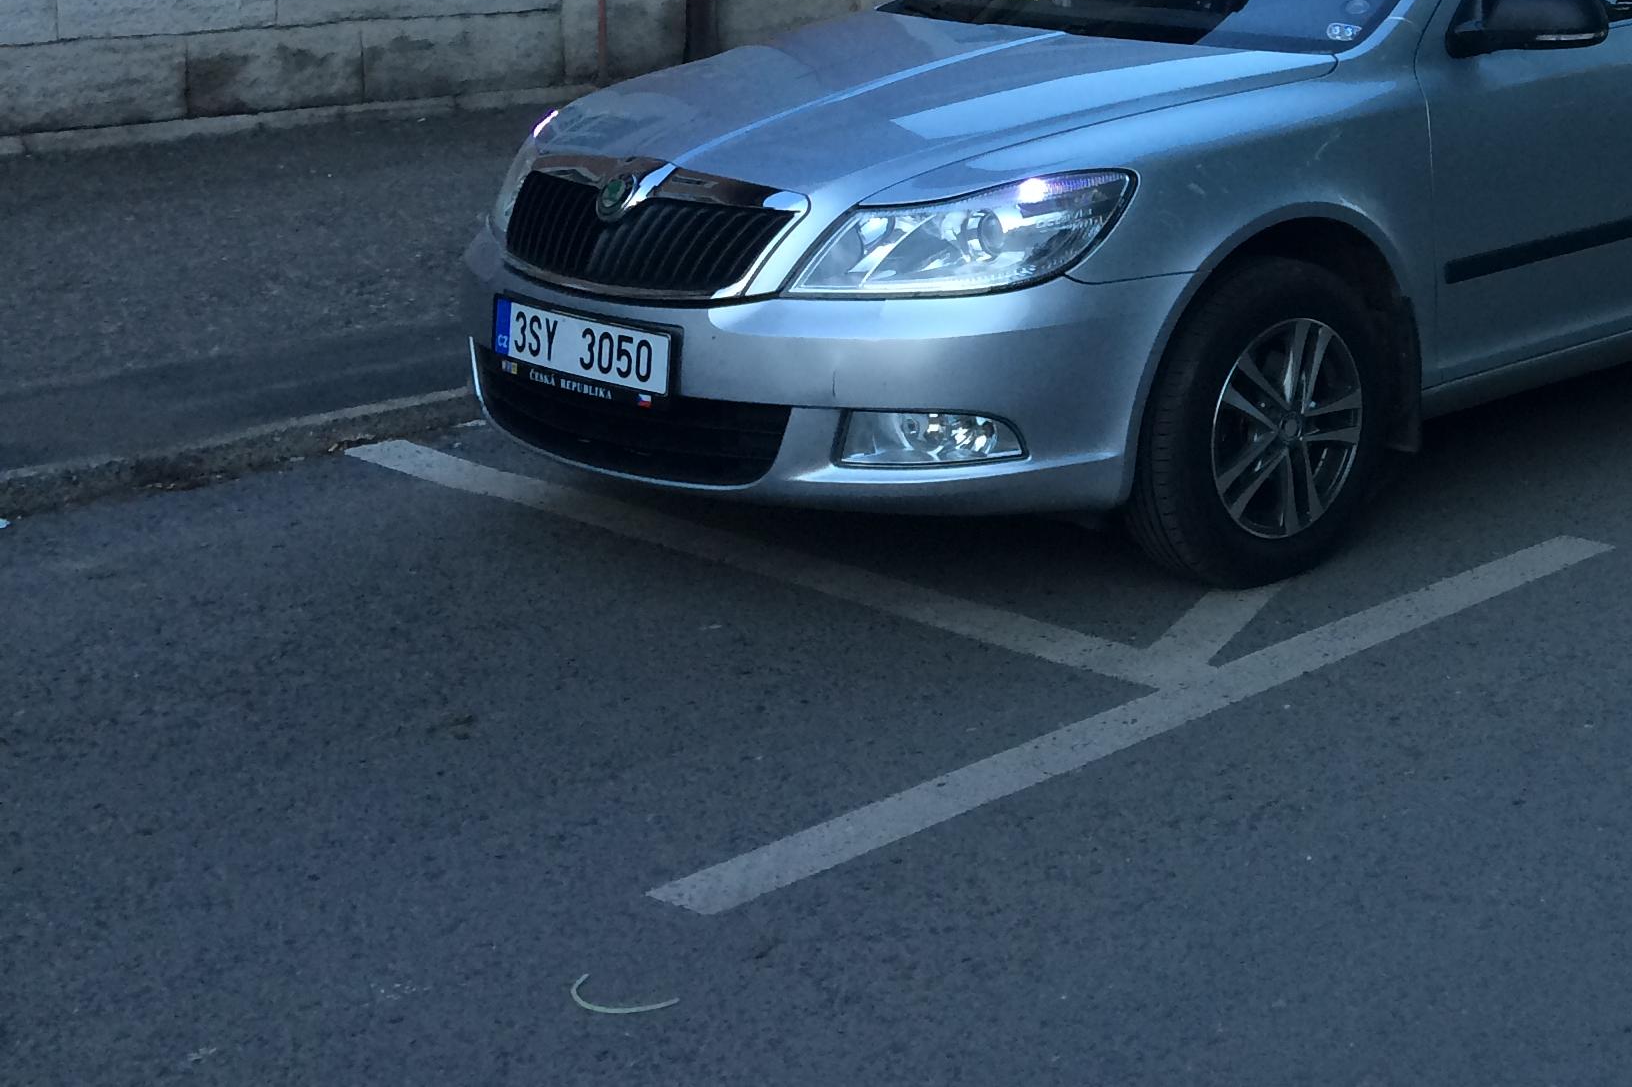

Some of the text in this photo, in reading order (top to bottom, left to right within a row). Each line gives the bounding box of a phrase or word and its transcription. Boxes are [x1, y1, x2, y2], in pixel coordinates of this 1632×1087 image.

[497, 333, 509, 349] CZ
[514, 311, 653, 383] 3SY 3050
[529, 369, 613, 400] ČESKÁ REPUBLIKA
